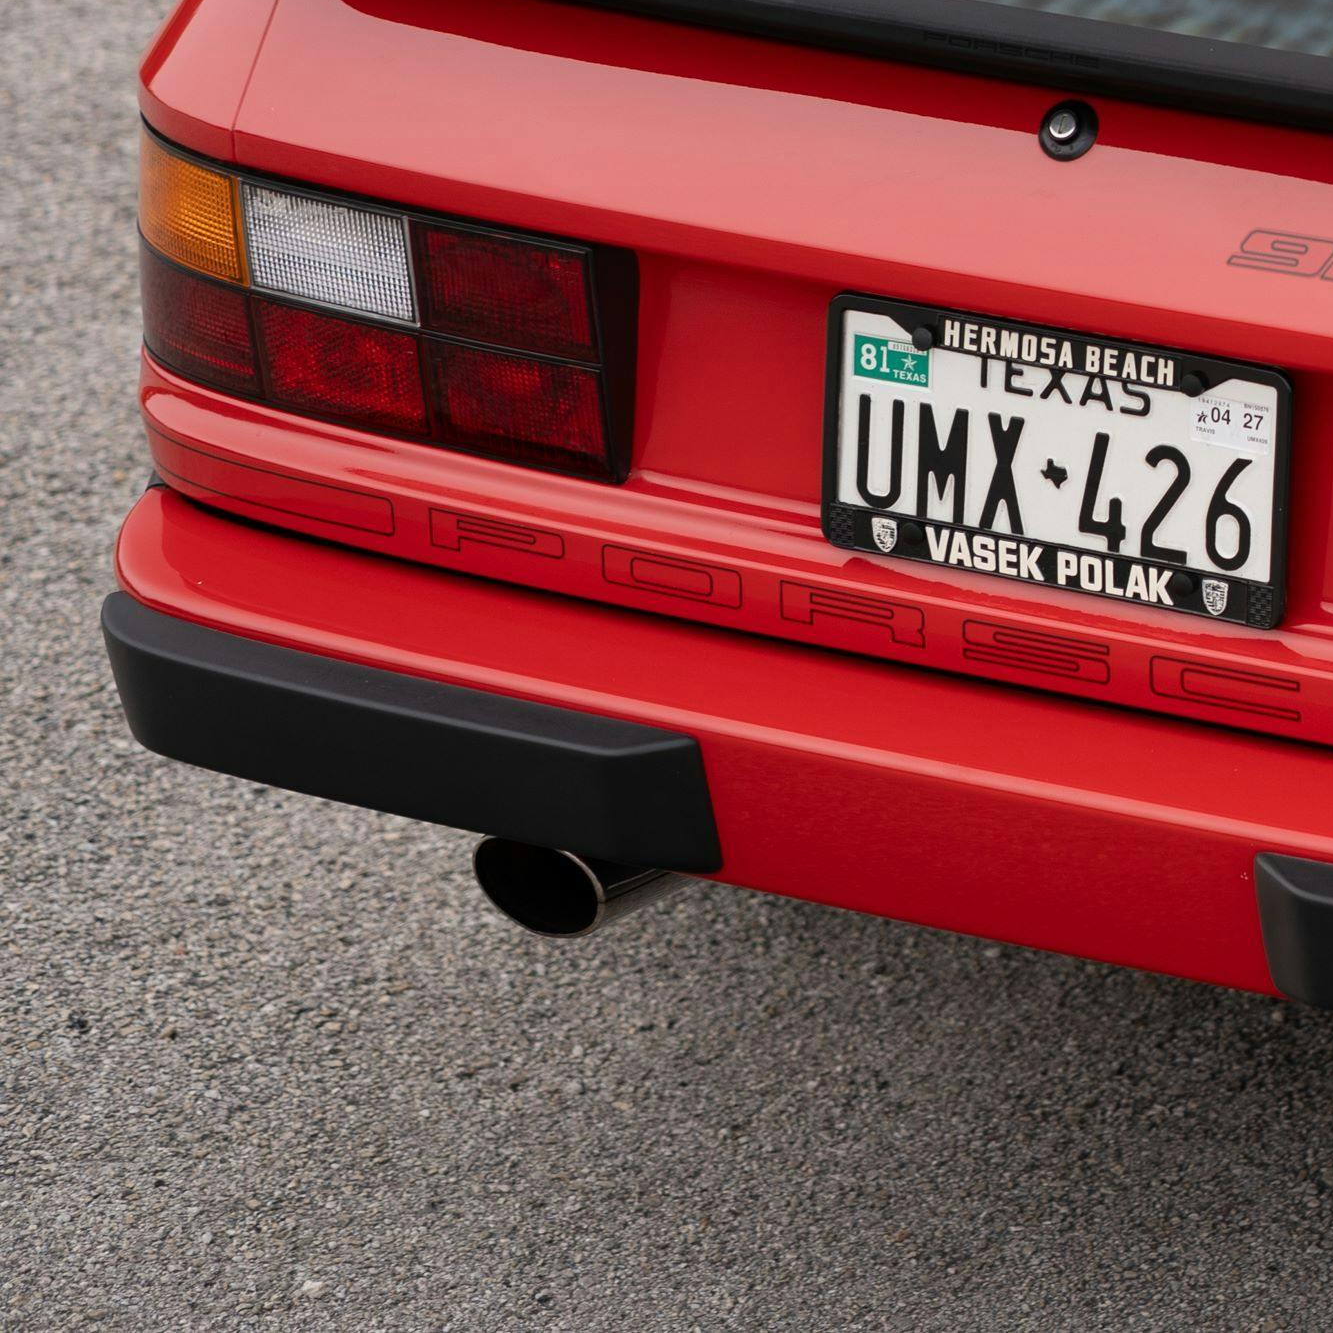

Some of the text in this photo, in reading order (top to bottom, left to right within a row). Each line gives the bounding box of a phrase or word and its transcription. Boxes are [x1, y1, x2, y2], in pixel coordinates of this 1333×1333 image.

[860, 343, 890, 373] 81
[893, 369, 927, 384] TEXAS
[944, 319, 1175, 387] HERMOSA BEACH
[1210, 406, 1231, 426] 04
[1242, 412, 1264, 431] 27
[856, 393, 1253, 571] UMX 426
[924, 525, 1174, 606] VASEK POLAK
